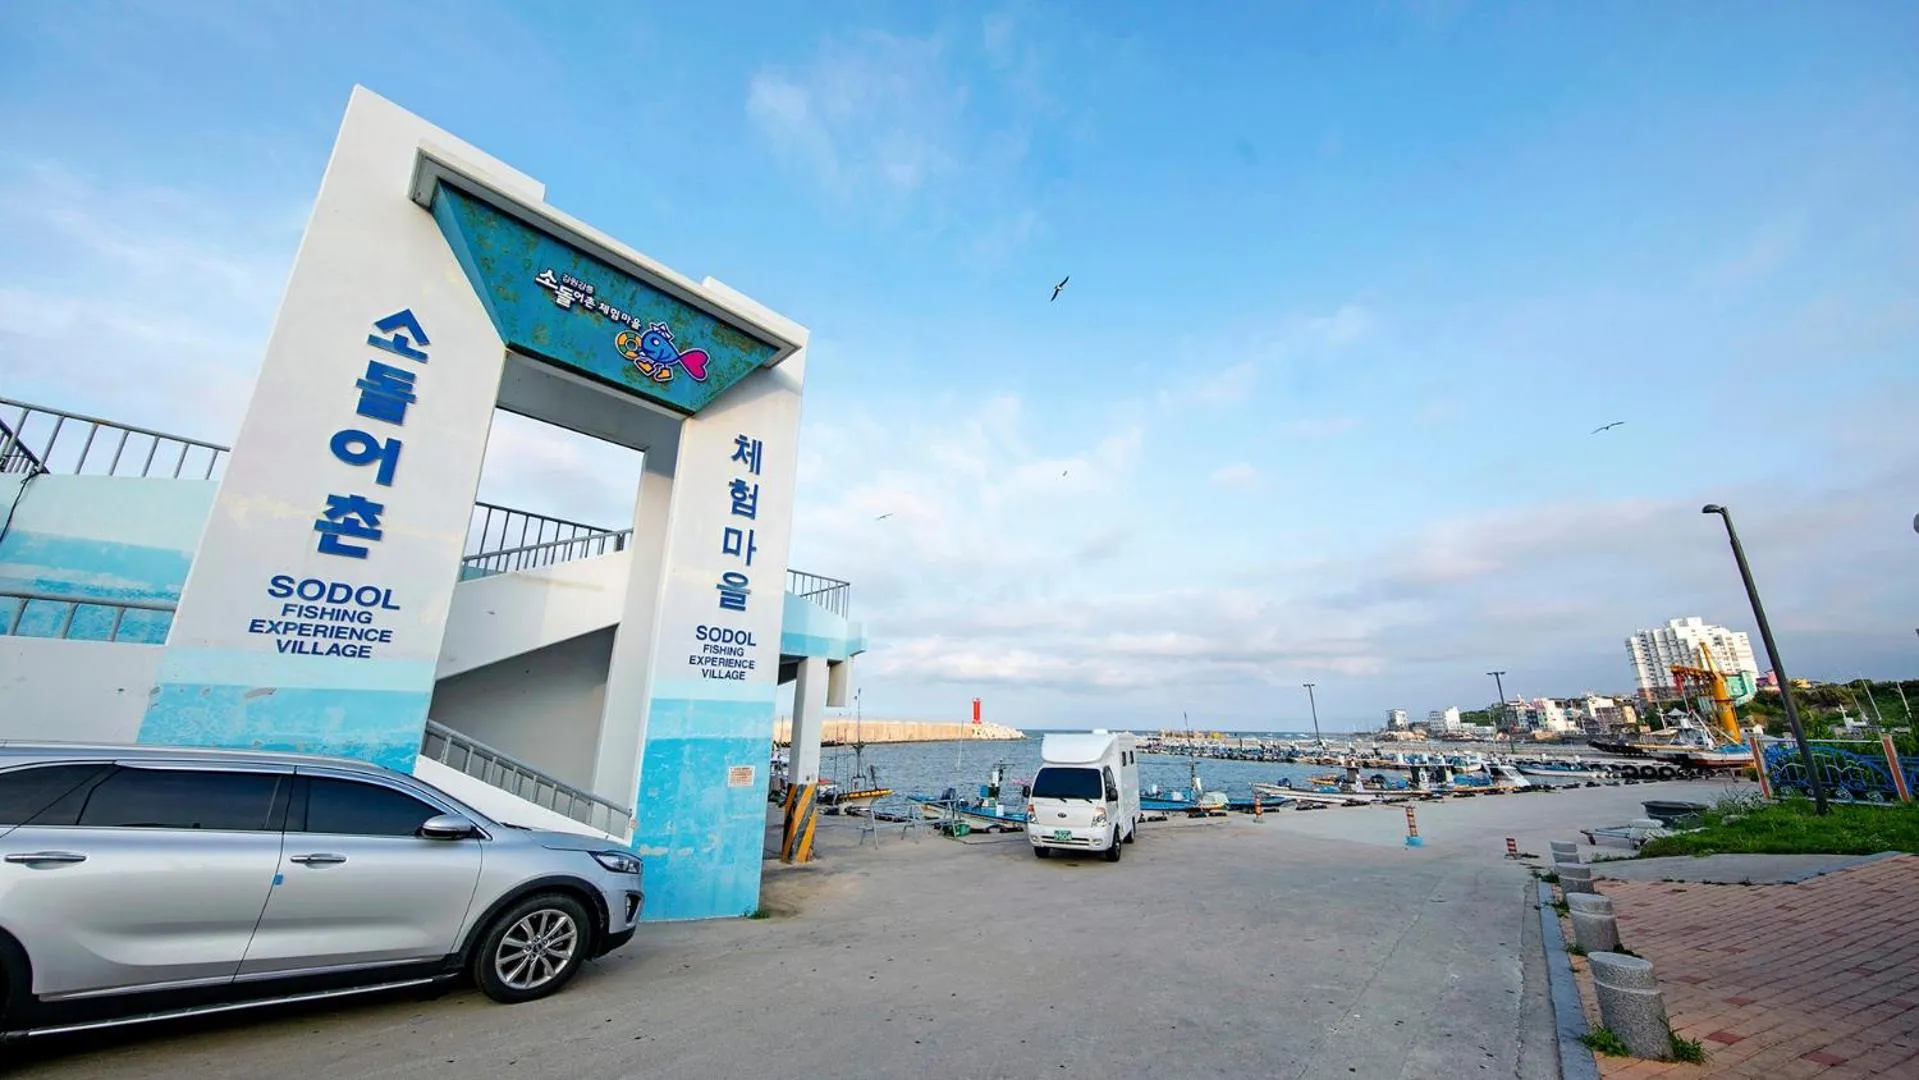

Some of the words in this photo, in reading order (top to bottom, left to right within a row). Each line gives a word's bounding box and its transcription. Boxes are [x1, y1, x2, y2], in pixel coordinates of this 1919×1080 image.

[535, 269, 596, 309] 소돌어촌
[598, 302, 641, 330] 체험마을
[314, 308, 431, 560] 소돌어촌
[716, 433, 763, 612] 체험마을
[267, 574, 401, 611] SODOL
[281, 603, 373, 625] FISHING
[248, 618, 393, 643] EXPERIENCE
[696, 625, 757, 647] SODOL
[276, 638, 372, 659] VILLAGE
[703, 644, 745, 657] FISHING
[689, 655, 755, 670] EXPERIENCE
[701, 668, 746, 681] VILLAGE
